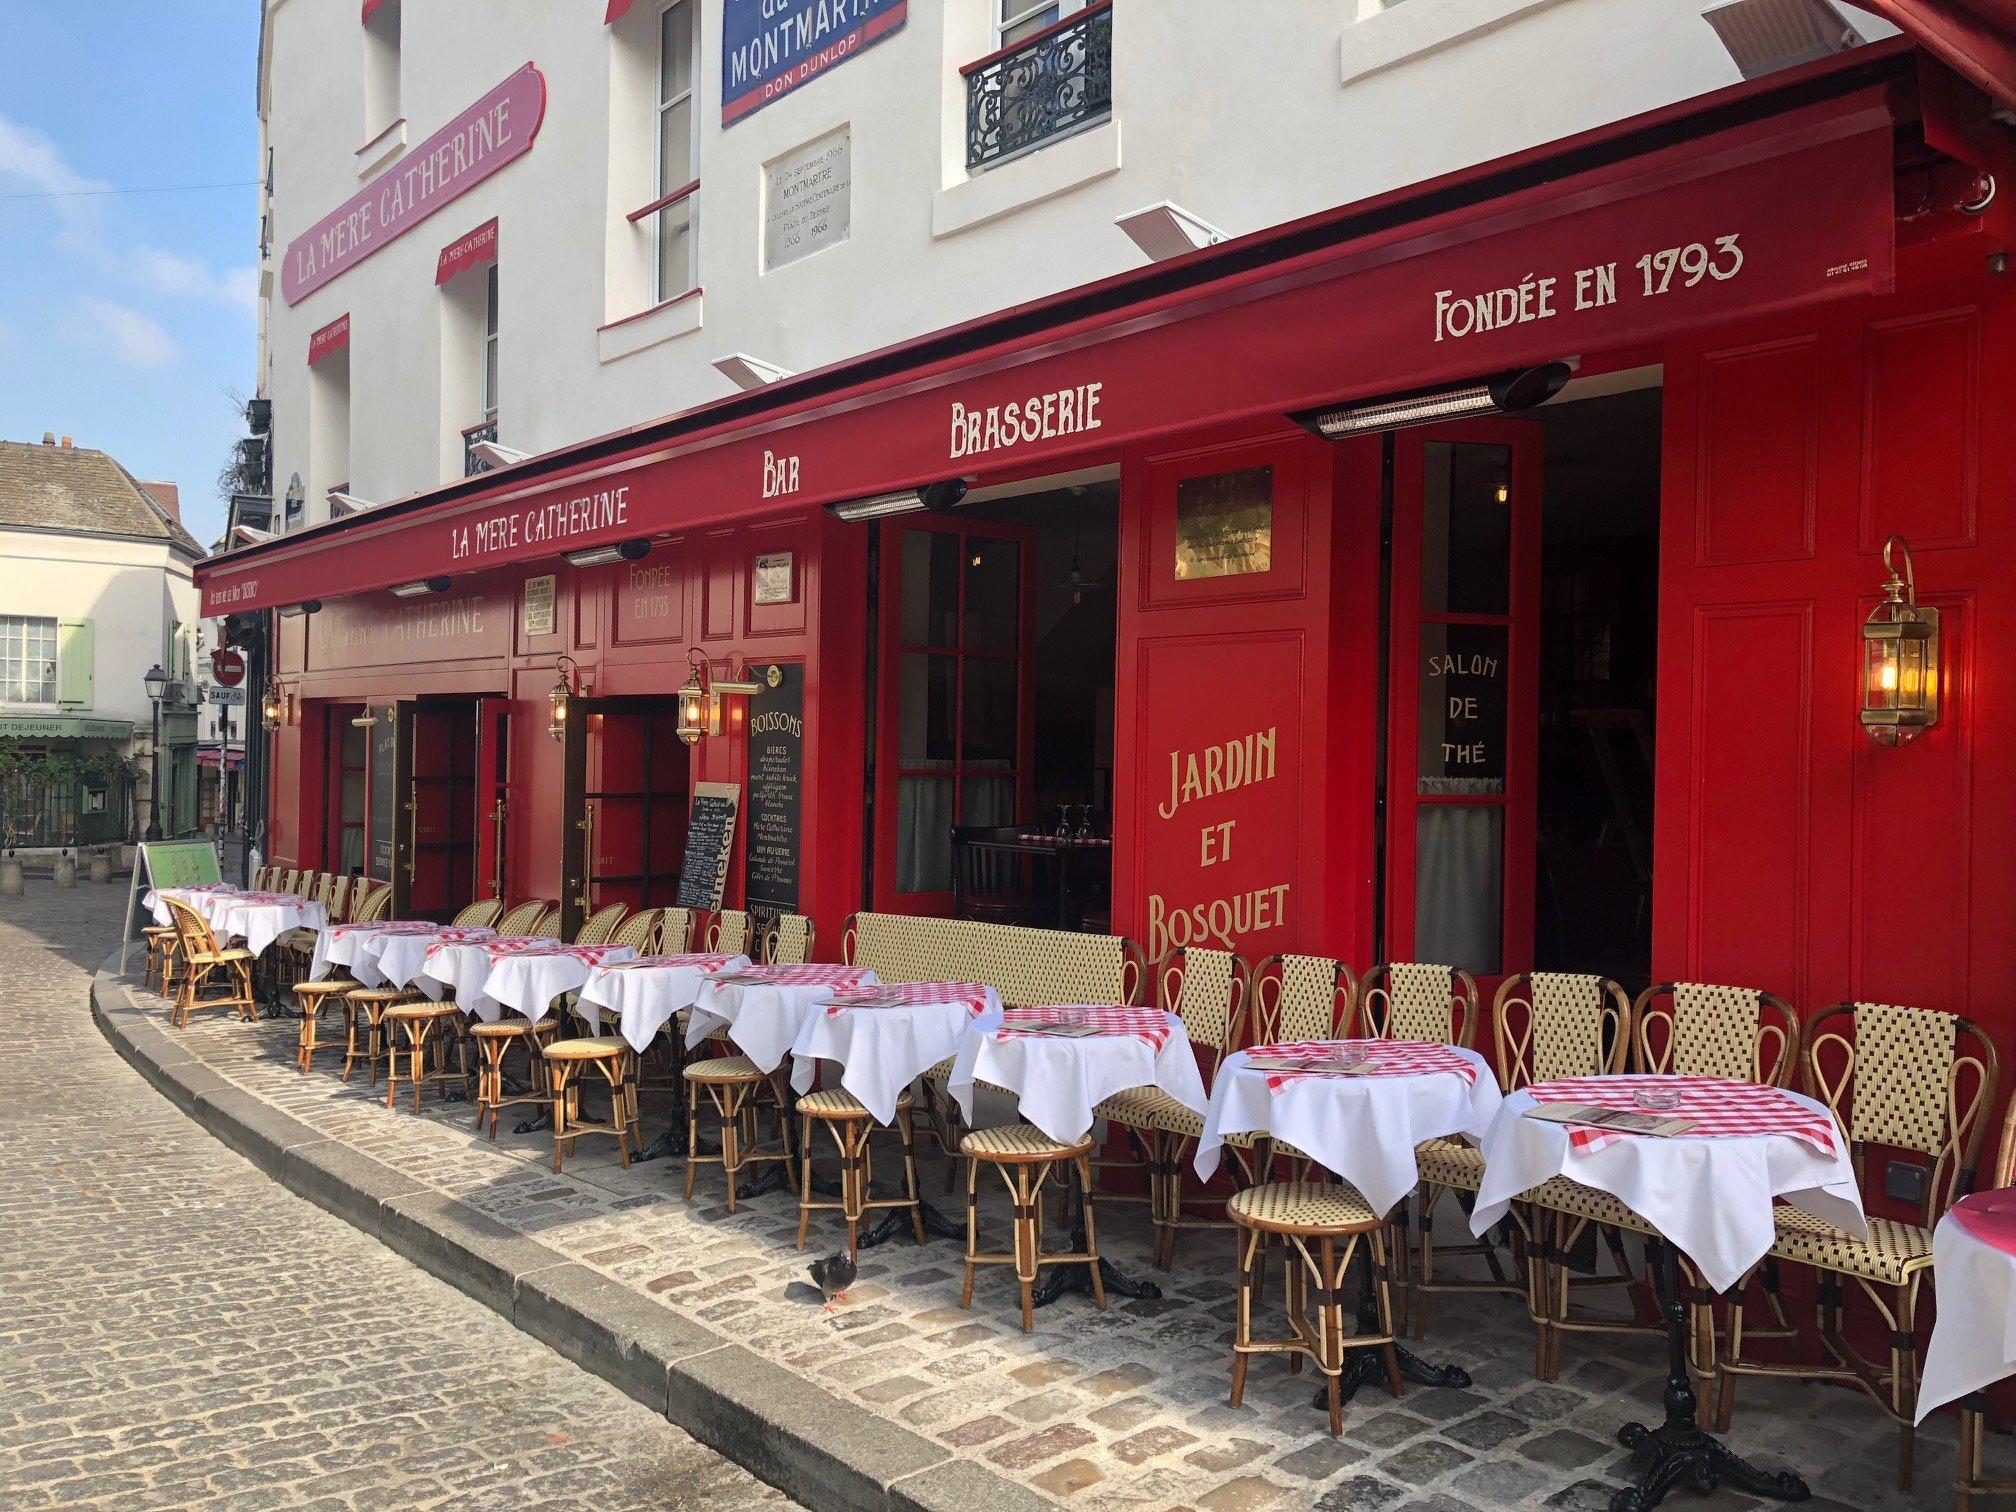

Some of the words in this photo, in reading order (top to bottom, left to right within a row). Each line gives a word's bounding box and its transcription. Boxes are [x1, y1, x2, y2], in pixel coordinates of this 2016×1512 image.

[731, 0, 879, 88] MONTMAR
[764, 73, 793, 98] DON
[800, 34, 856, 78] DUNLOP
[296, 242, 317, 285] LA
[320, 201, 373, 269] MERE
[379, 97, 513, 228] CATHERINE
[783, 166, 832, 200] MONTMARTRE
[1434, 272, 1557, 342] FONDÉE
[1575, 262, 1618, 312] EN
[1635, 233, 1744, 297] 1793
[950, 382, 1103, 459] BRASSERIE
[762, 450, 800, 499] BAR
[452, 526, 470, 559] LA
[475, 513, 520, 554] MERE
[524, 486, 630, 544] CATHERINE
[630, 563, 671, 592] FONDÉE
[384, 595, 485, 641] CATHERINE
[635, 597, 648, 619] EN
[650, 595, 669, 618] 1793
[1428, 654, 1498, 678] SALON
[210, 691, 230, 700] SAUF
[1449, 696, 1478, 719] DE
[751, 711, 802, 738] BOISSONS
[766, 744, 787, 755] BIÈRES
[1441, 740, 1486, 764] THÉ
[1158, 726, 1276, 820] JARDIN
[761, 813, 787, 823] COCKTAILS
[710, 815, 734, 914] eineken
[775, 847, 791, 857] VERRE
[1200, 819, 1236, 868] ET
[1148, 883, 1290, 966] BOSQUET
